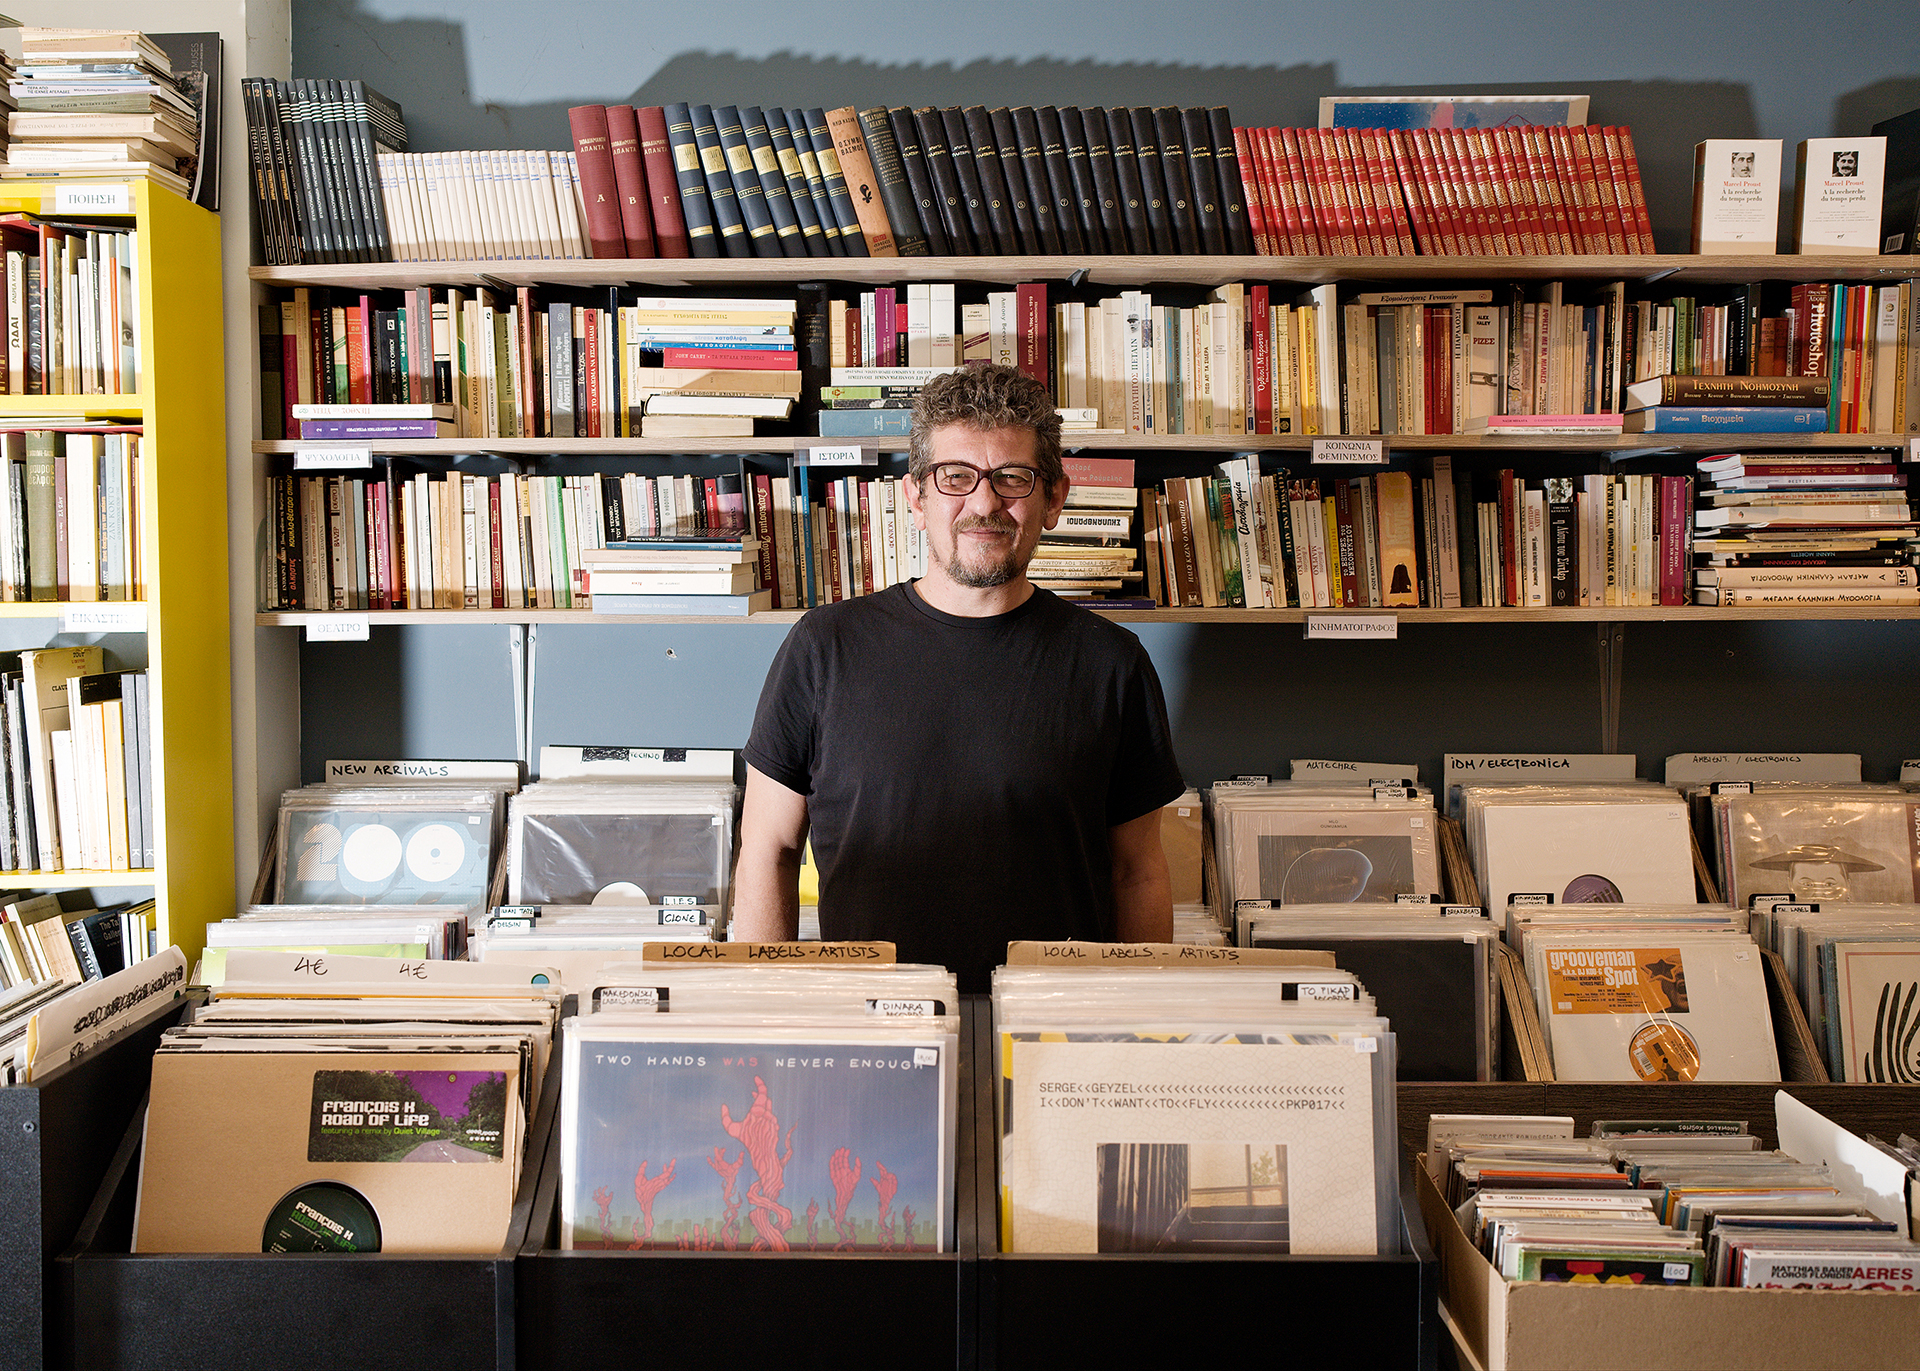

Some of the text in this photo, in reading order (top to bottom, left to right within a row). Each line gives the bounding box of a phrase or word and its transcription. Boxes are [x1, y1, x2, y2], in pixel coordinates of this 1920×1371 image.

[68, 194, 115, 204] ΠΟΙΗΣΗ
[1803, 303, 1826, 378] Photoshop
[1325, 442, 1372, 450] ΚΟΙΝΩΝΙΑ
[305, 453, 361, 461] ΨΥΧΟΛΟΓΙΑ
[819, 452, 855, 460] ΙΣΤΟΡΙΑ
[1318, 453, 1378, 461] ΦΕΜΙΝΙΣΜΟΣ
[317, 623, 361, 633] ΘΕΑΤΡΟ
[1310, 623, 1395, 632] ΚΙΝΗΜΑΤΟΓΡΑΦΟΣ
[331, 764, 367, 778] NEW
[1306, 762, 1358, 771] AUTECHRE
[665, 914, 696, 923] CLONE
[663, 945, 727, 959] LOCAL
[1044, 946, 1087, 959] LOCAL
[294, 956, 429, 980] 4€ 4€
[1550, 951, 1639, 988] grooveman Spot
[1301, 987, 1350, 995] TO PIKAP
[882, 1002, 924, 1012] DINARA
[595, 1055, 923, 1070] TWO HANDS WAS NEVER ENOUGH
[321, 1127, 353, 1135] featuring
[383, 1128, 392, 1136] by
[416, 1127, 440, 1136] Village
[1852, 1267, 1913, 1280] AERES
